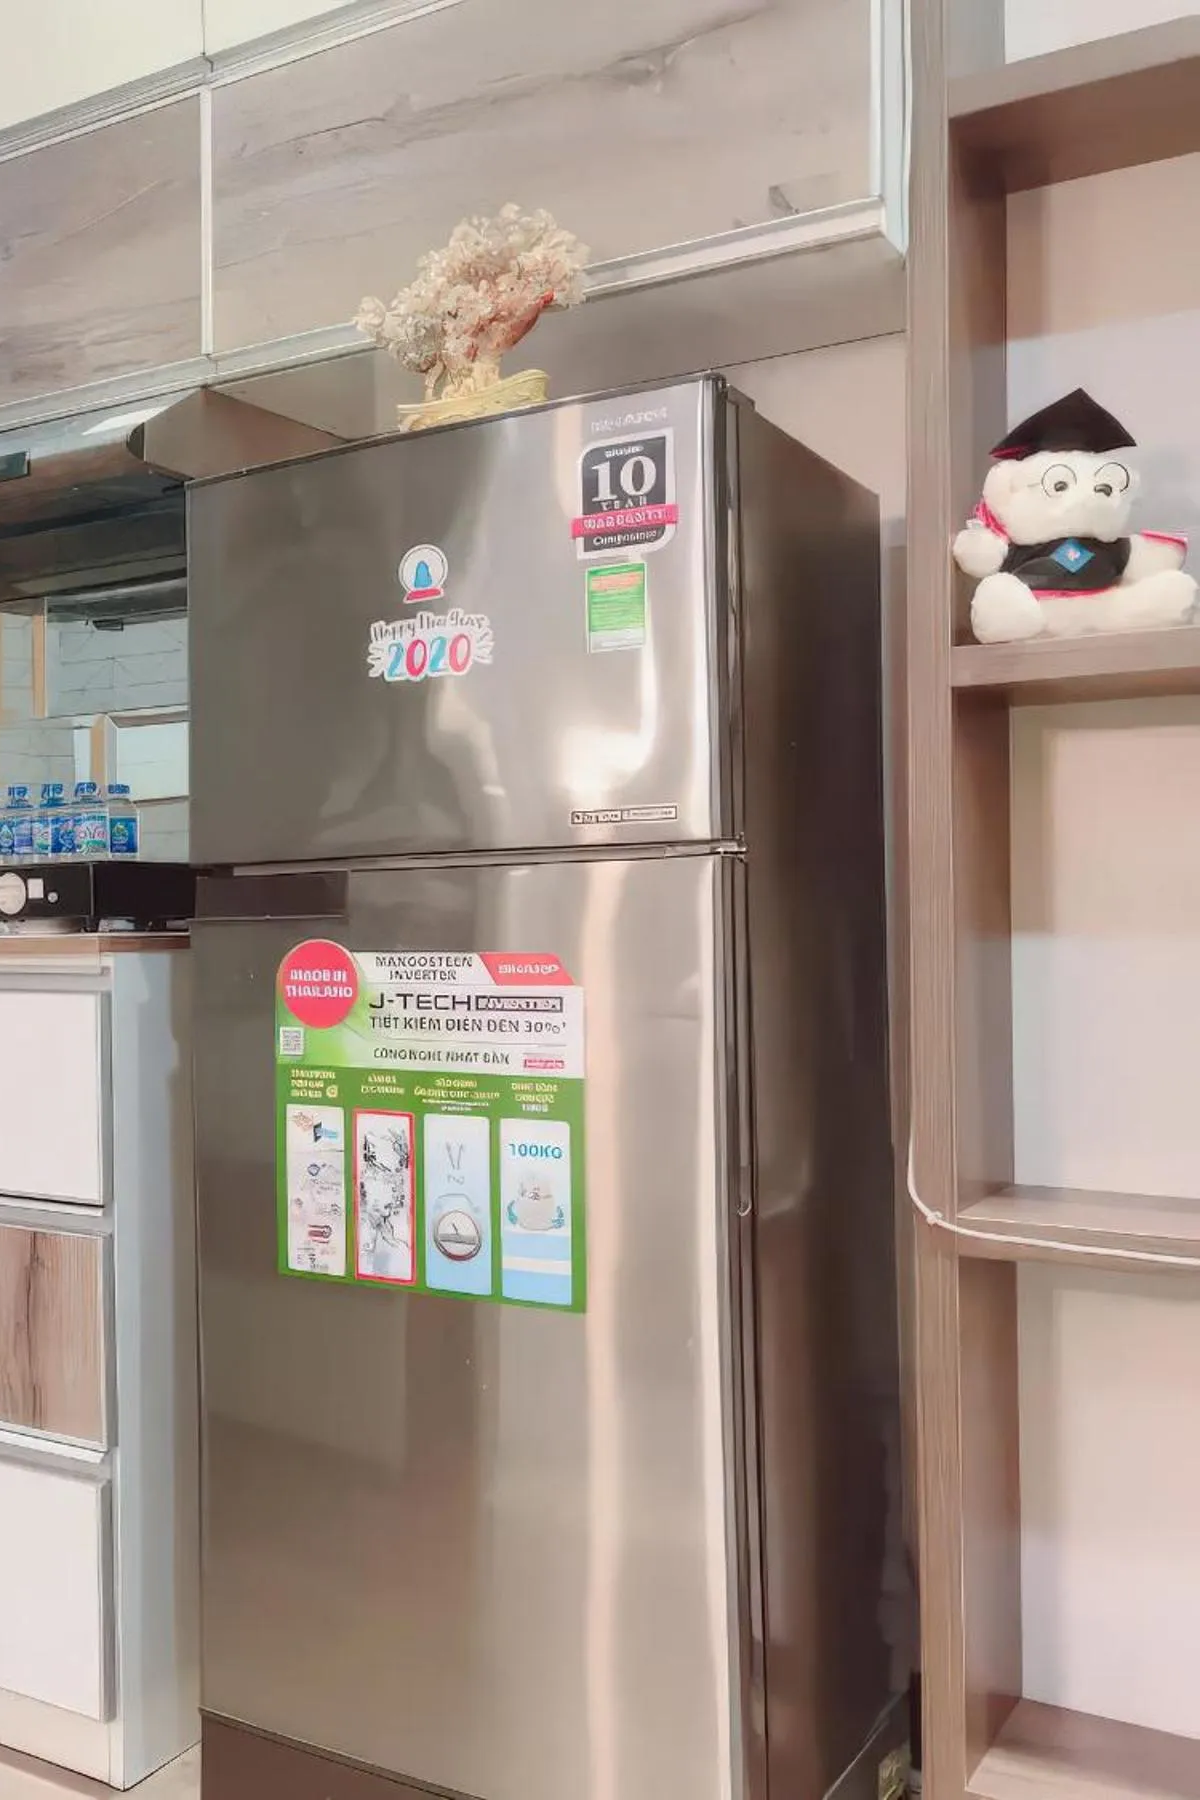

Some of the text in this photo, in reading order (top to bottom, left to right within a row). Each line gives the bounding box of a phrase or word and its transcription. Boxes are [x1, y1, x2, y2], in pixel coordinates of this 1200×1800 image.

[592, 456, 657, 502] 10
[388, 633, 471, 678] 2020
[369, 993, 472, 1011] J-TECH
